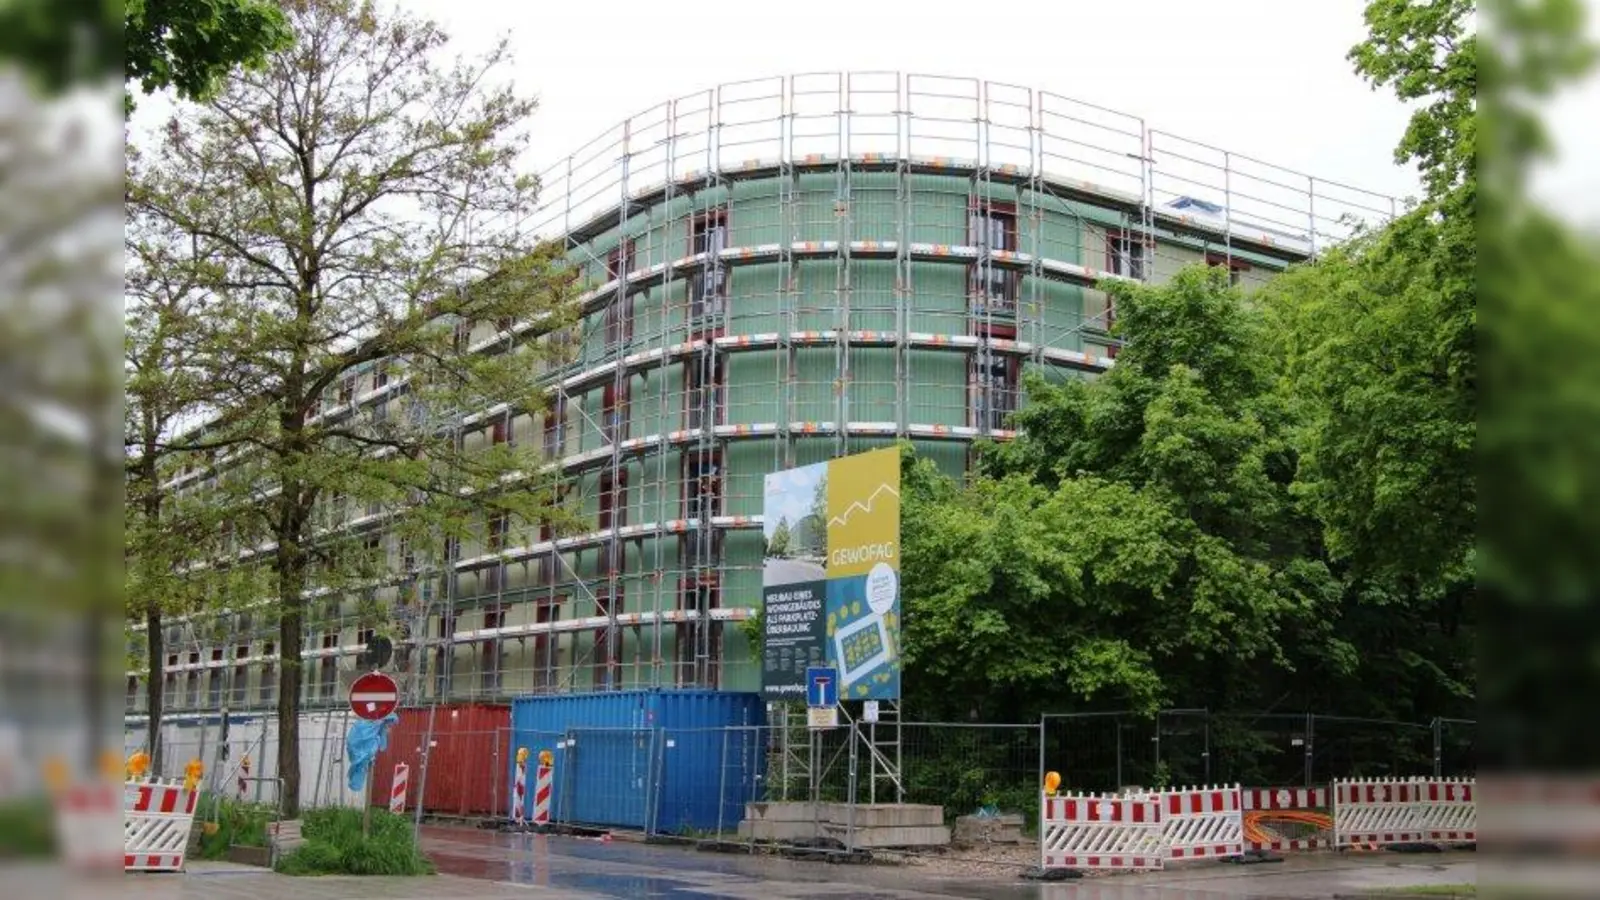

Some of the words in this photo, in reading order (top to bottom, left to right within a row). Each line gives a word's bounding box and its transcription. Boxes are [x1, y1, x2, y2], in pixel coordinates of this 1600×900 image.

[832, 541, 893, 566] GEWOFAG
[766, 592, 793, 603] NEUBAU
[794, 590, 812, 600] EINES
[766, 600, 821, 613] WOHNGEBÄUDES
[766, 614, 778, 624] ALS
[766, 622, 811, 635] ÜBERBAUUNG
